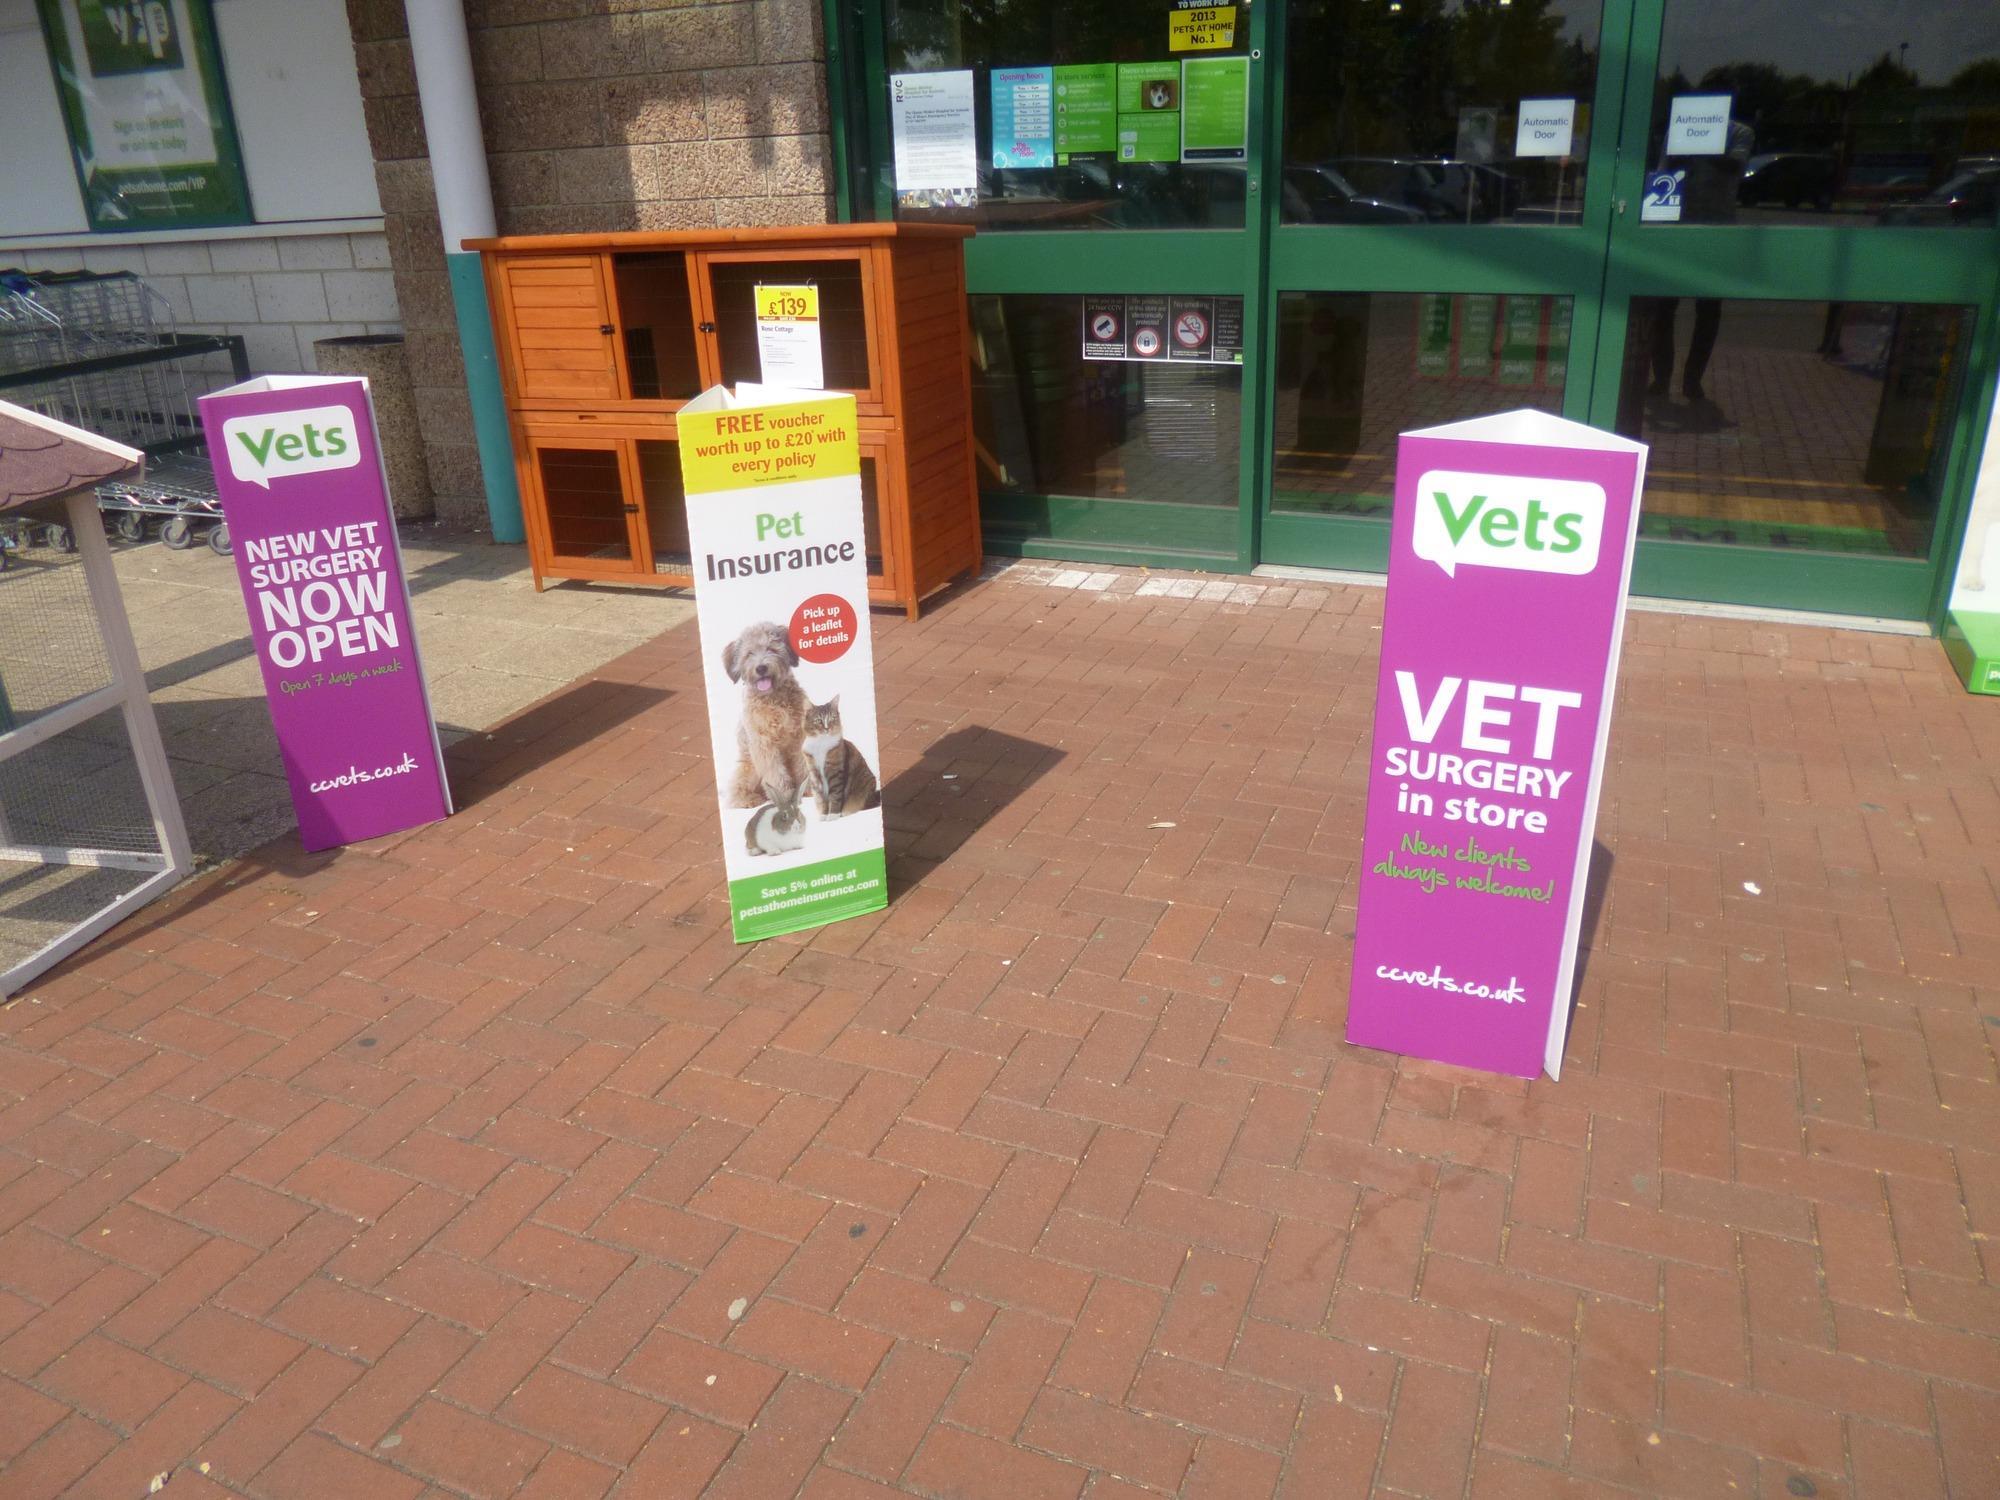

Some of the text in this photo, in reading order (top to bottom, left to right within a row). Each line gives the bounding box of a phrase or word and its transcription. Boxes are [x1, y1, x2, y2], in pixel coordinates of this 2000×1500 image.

[1190, 0, 1213, 8] WORK
[1190, 11, 1217, 22] 2013
[1173, 22, 1233, 34] PETS AT HOME
[894, 79, 904, 103] RVC
[1523, 118, 1569, 127] Automatic
[1534, 130, 1556, 139] Door
[1675, 115, 1724, 124] Automatic
[1686, 128, 1710, 137] Door
[768, 298, 807, 316] £139
[715, 412, 825, 436] FREE voucher
[235, 423, 348, 468] Vets
[696, 439, 739, 458] worth
[744, 439, 761, 454] up
[766, 437, 780, 450] to
[817, 427, 846, 444] with
[731, 452, 816, 474] every policy
[755, 511, 805, 542] Pet
[1432, 492, 1584, 554] Vets
[244, 521, 378, 563] NEW VET
[250, 546, 383, 589] SURGERY
[706, 541, 855, 582] Insurance
[258, 571, 387, 632] NOW
[803, 606, 840, 620] Pick up
[268, 612, 400, 669] OPEN
[798, 632, 849, 650] for details
[802, 619, 843, 635] a leaflet
[279, 657, 403, 696] Open 7 days a week
[1394, 670, 1583, 761] VET
[309, 752, 419, 793] ccvets.co.uk
[1384, 746, 1573, 800] SURGERY
[1397, 782, 1548, 834] in store
[1401, 830, 1532, 872] New clients
[761, 868, 857, 899] Save 5% online at
[1373, 851, 1555, 904] always welcome!
[739, 878, 880, 921] petsathomeinsurance.com
[1376, 965, 1526, 1004] ccvets.co.uk
